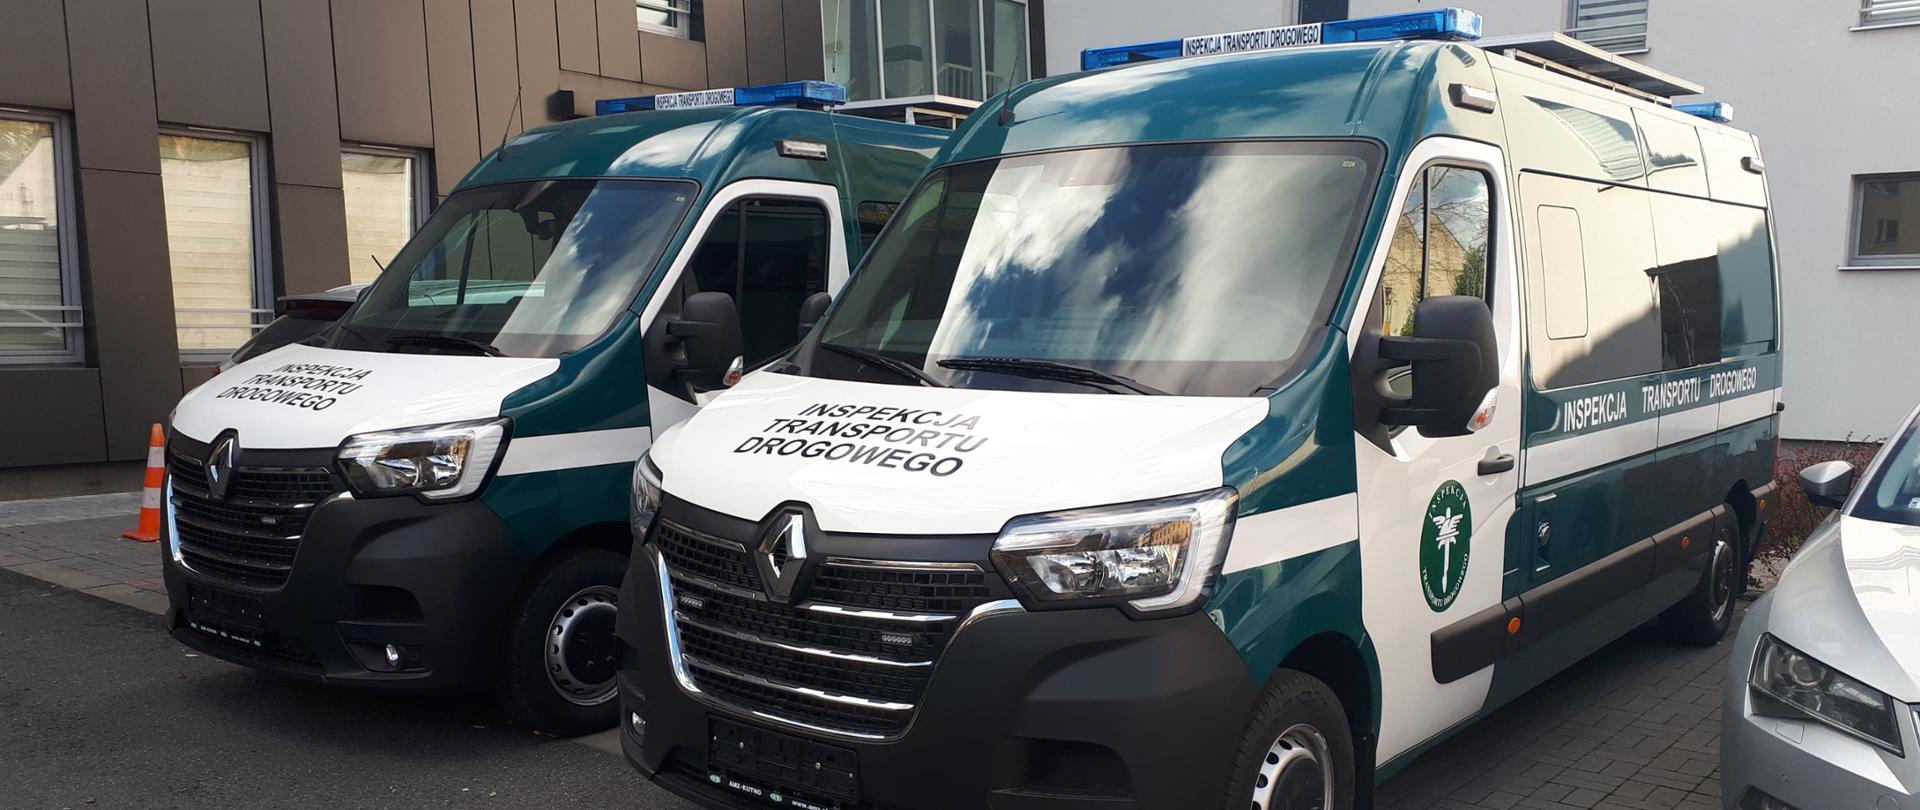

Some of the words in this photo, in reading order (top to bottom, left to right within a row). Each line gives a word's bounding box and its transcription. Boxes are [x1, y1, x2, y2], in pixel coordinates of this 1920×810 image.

[1184, 35, 1221, 56] INSPEKCJA
[1223, 30, 1270, 52] TRANSPORTU
[1271, 25, 1319, 48] DROGOWEGO
[656, 95, 678, 109] INSPEKCJA
[678, 92, 705, 107] TRANSPORTU
[705, 89, 733, 105] DROGOWEGO
[242, 374, 363, 395] TRANSPORTU
[272, 363, 373, 381] INSPEKCJA
[216, 386, 337, 411] DROGOWEGO
[1563, 391, 1627, 432] INSPEKCJA
[1642, 376, 1701, 413] TRANSPORTU
[1709, 366, 1757, 398] DROGOWEGO
[798, 403, 981, 430] INSPEKCJA
[763, 418, 989, 453] TRANSPORTU
[733, 436, 964, 477] DROGOWEGO
[1428, 485, 1467, 519] INSPEKCJA
